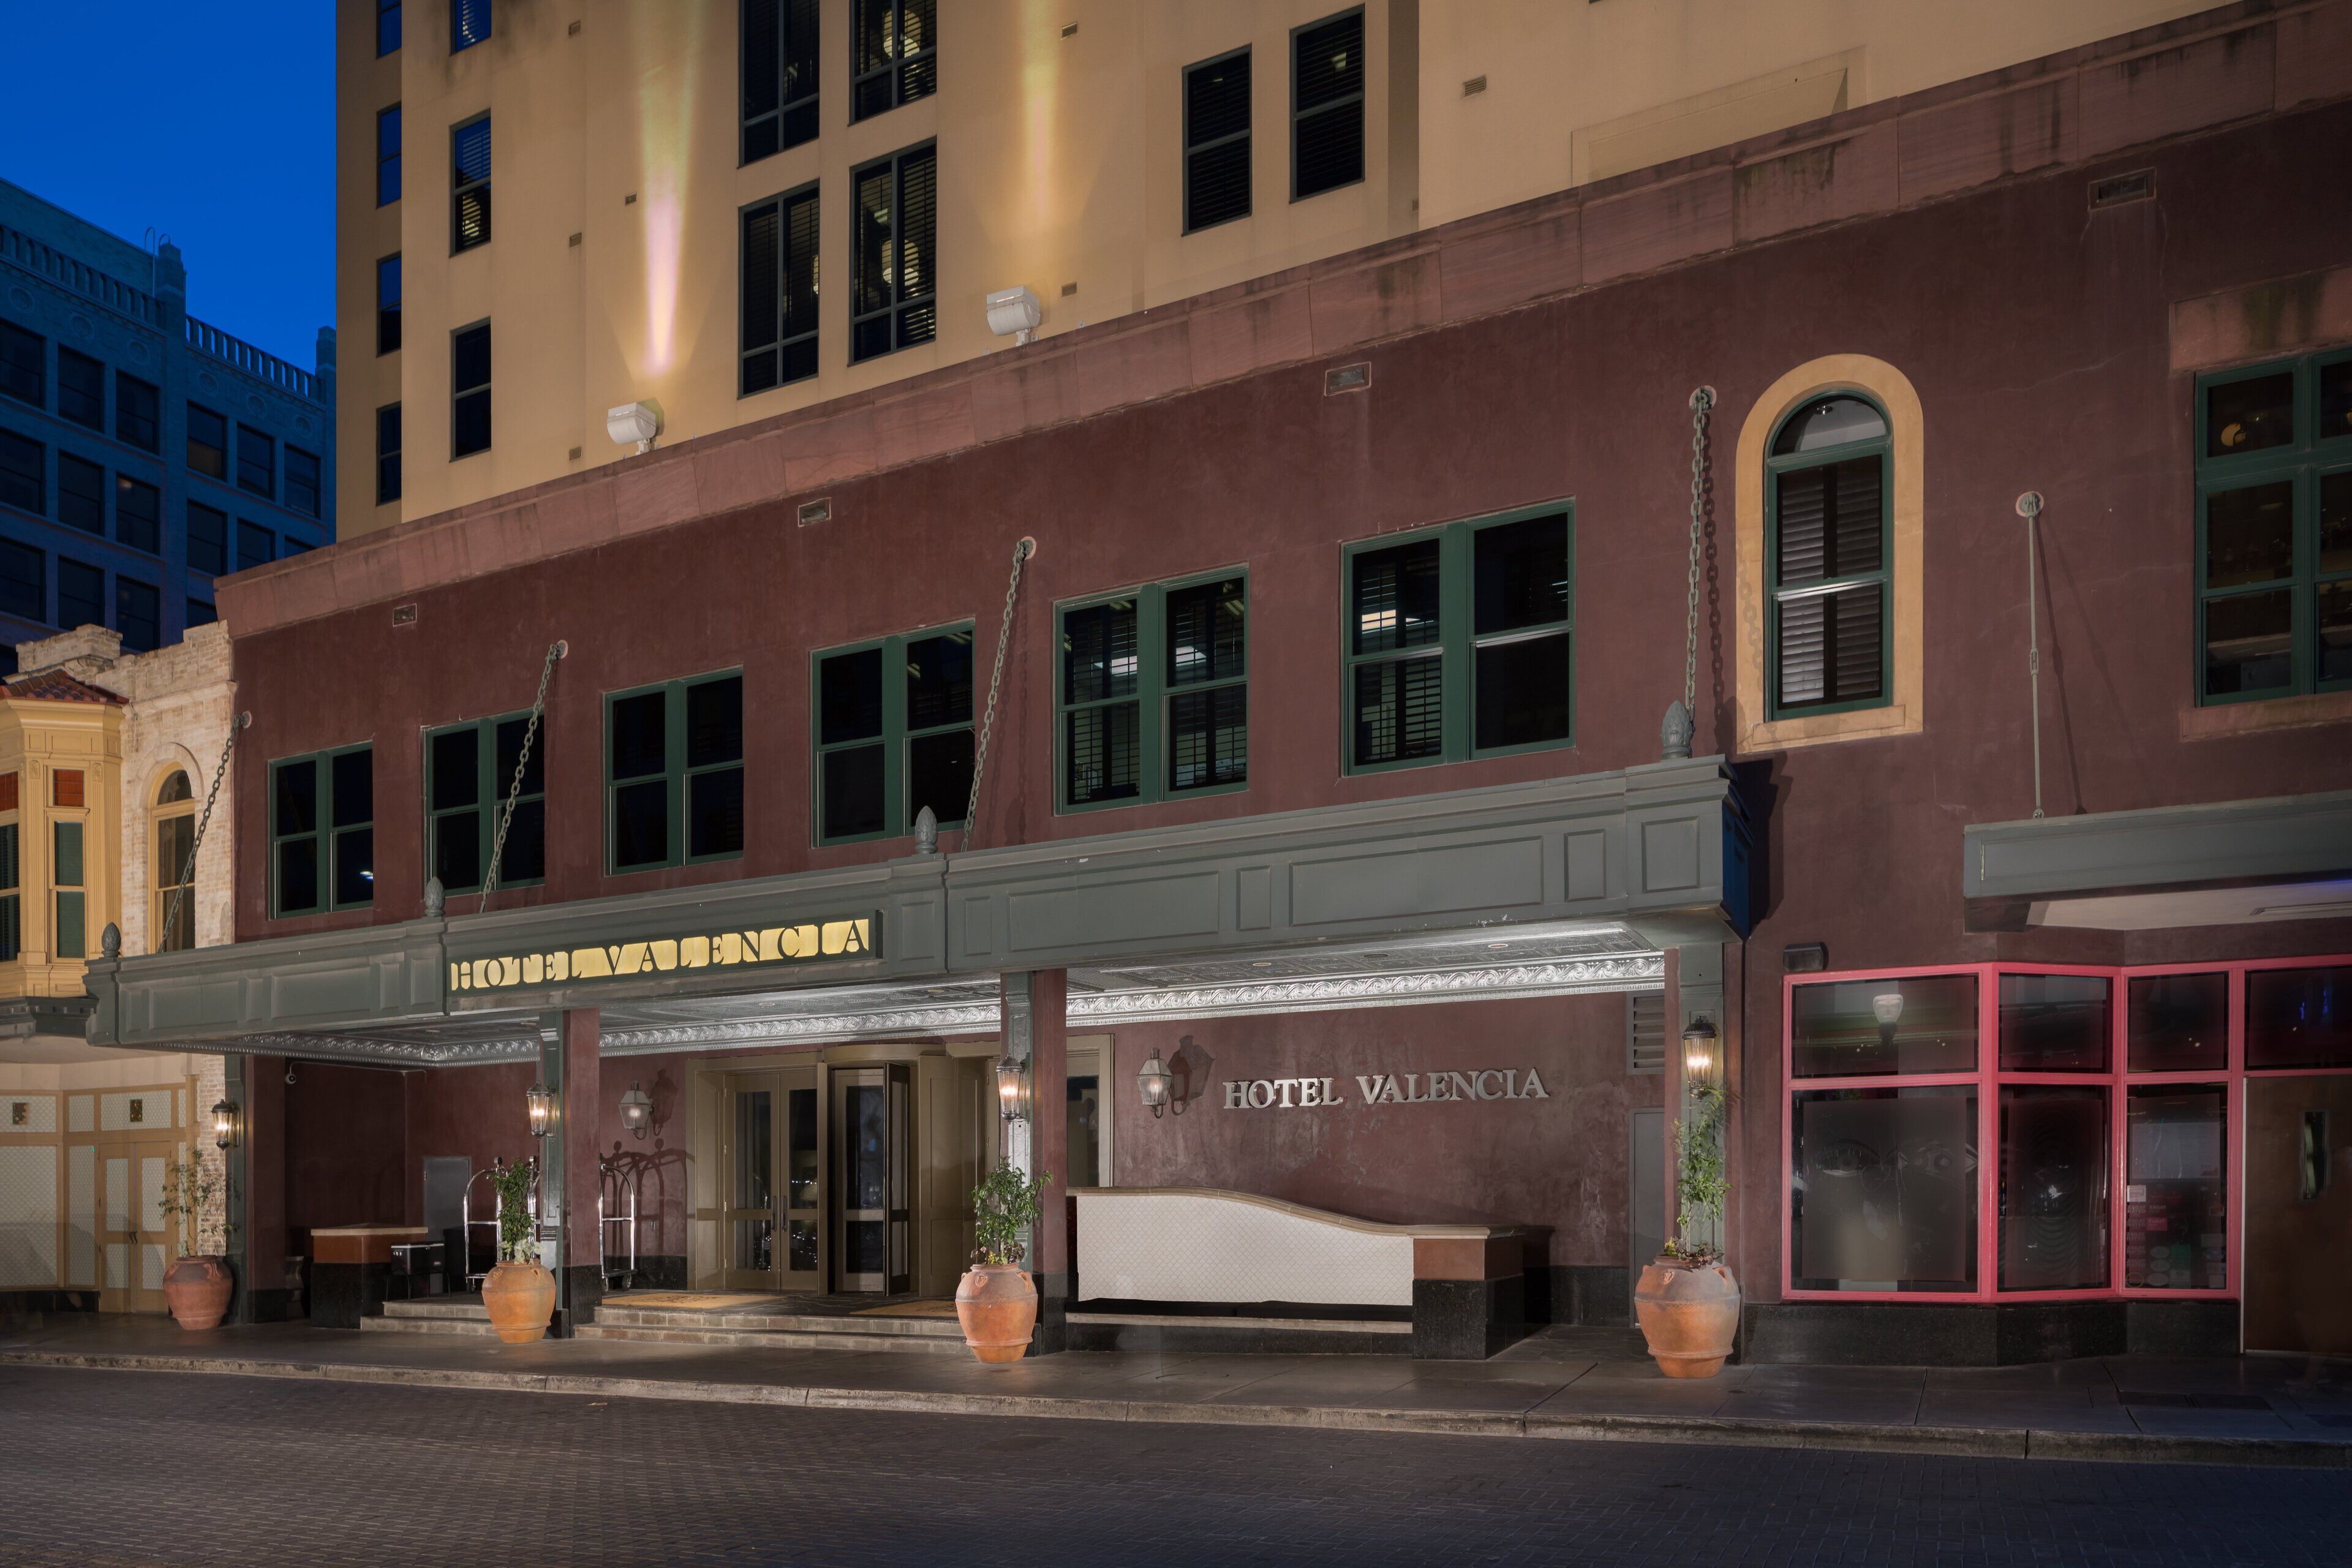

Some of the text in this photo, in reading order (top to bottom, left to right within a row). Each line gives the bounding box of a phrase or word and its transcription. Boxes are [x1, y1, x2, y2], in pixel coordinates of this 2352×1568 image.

[451, 919, 869, 990] HOTEL VALENCIA
[1223, 1067, 1550, 1109] HOTEL VALENCIA
